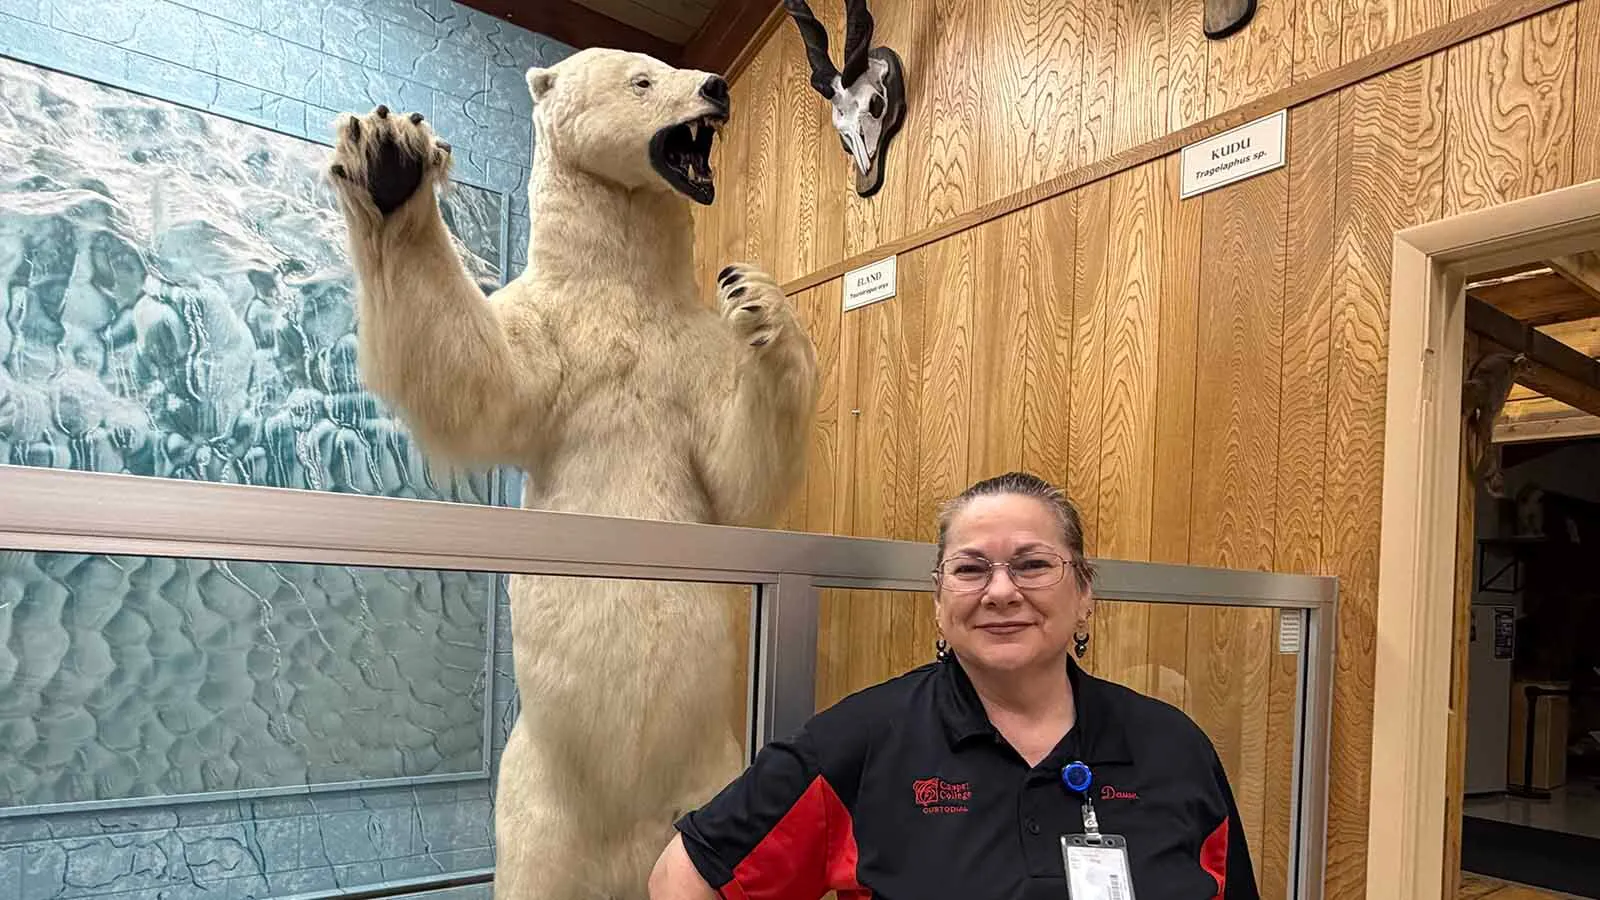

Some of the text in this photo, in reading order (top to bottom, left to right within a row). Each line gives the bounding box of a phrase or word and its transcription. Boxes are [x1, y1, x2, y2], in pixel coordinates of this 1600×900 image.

[1211, 137, 1251, 160] KUDU
[1195, 149, 1268, 179] Tragelaphus sp.
[857, 271, 882, 287] ELAND
